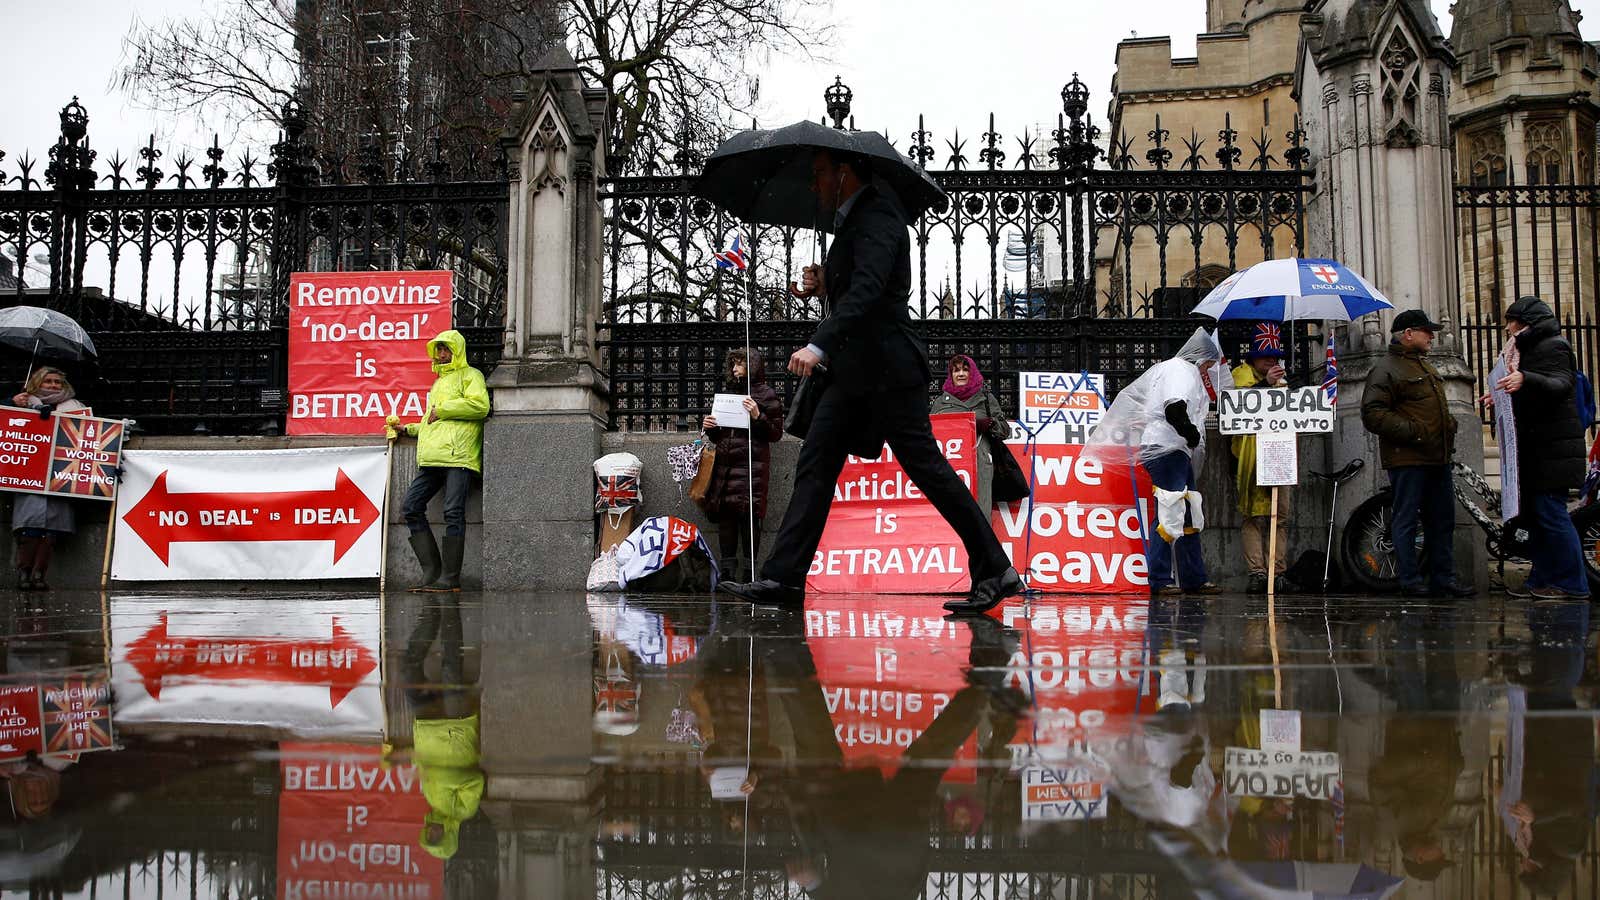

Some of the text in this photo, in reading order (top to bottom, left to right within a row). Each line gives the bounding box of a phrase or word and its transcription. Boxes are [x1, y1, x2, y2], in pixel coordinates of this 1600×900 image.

[298, 280, 441, 306] Removing
[1311, 283, 1356, 292] ENGLAND
[355, 352, 377, 377] is
[1025, 375, 1099, 391] LEAVE
[1034, 393, 1090, 407] MEANS
[1220, 389, 1332, 415] NO DEAL
[1025, 409, 1100, 425] LEAVE
[1221, 417, 1264, 432] LET'S
[1292, 418, 1330, 431] WTO
[5, 430, 51, 444] MILLION
[79, 439, 101, 450] THE
[0, 454, 30, 467] OUT
[65, 449, 109, 462] WORLD
[80, 463, 92, 472] IS
[1031, 455, 1104, 486] we
[54, 471, 114, 485] WATCHING
[269, 512, 281, 521] IS
[294, 508, 361, 525] IDEAL
[874, 508, 898, 534] is
[1000, 497, 1149, 540] Voted
[806, 547, 963, 576] BETRAYAL
